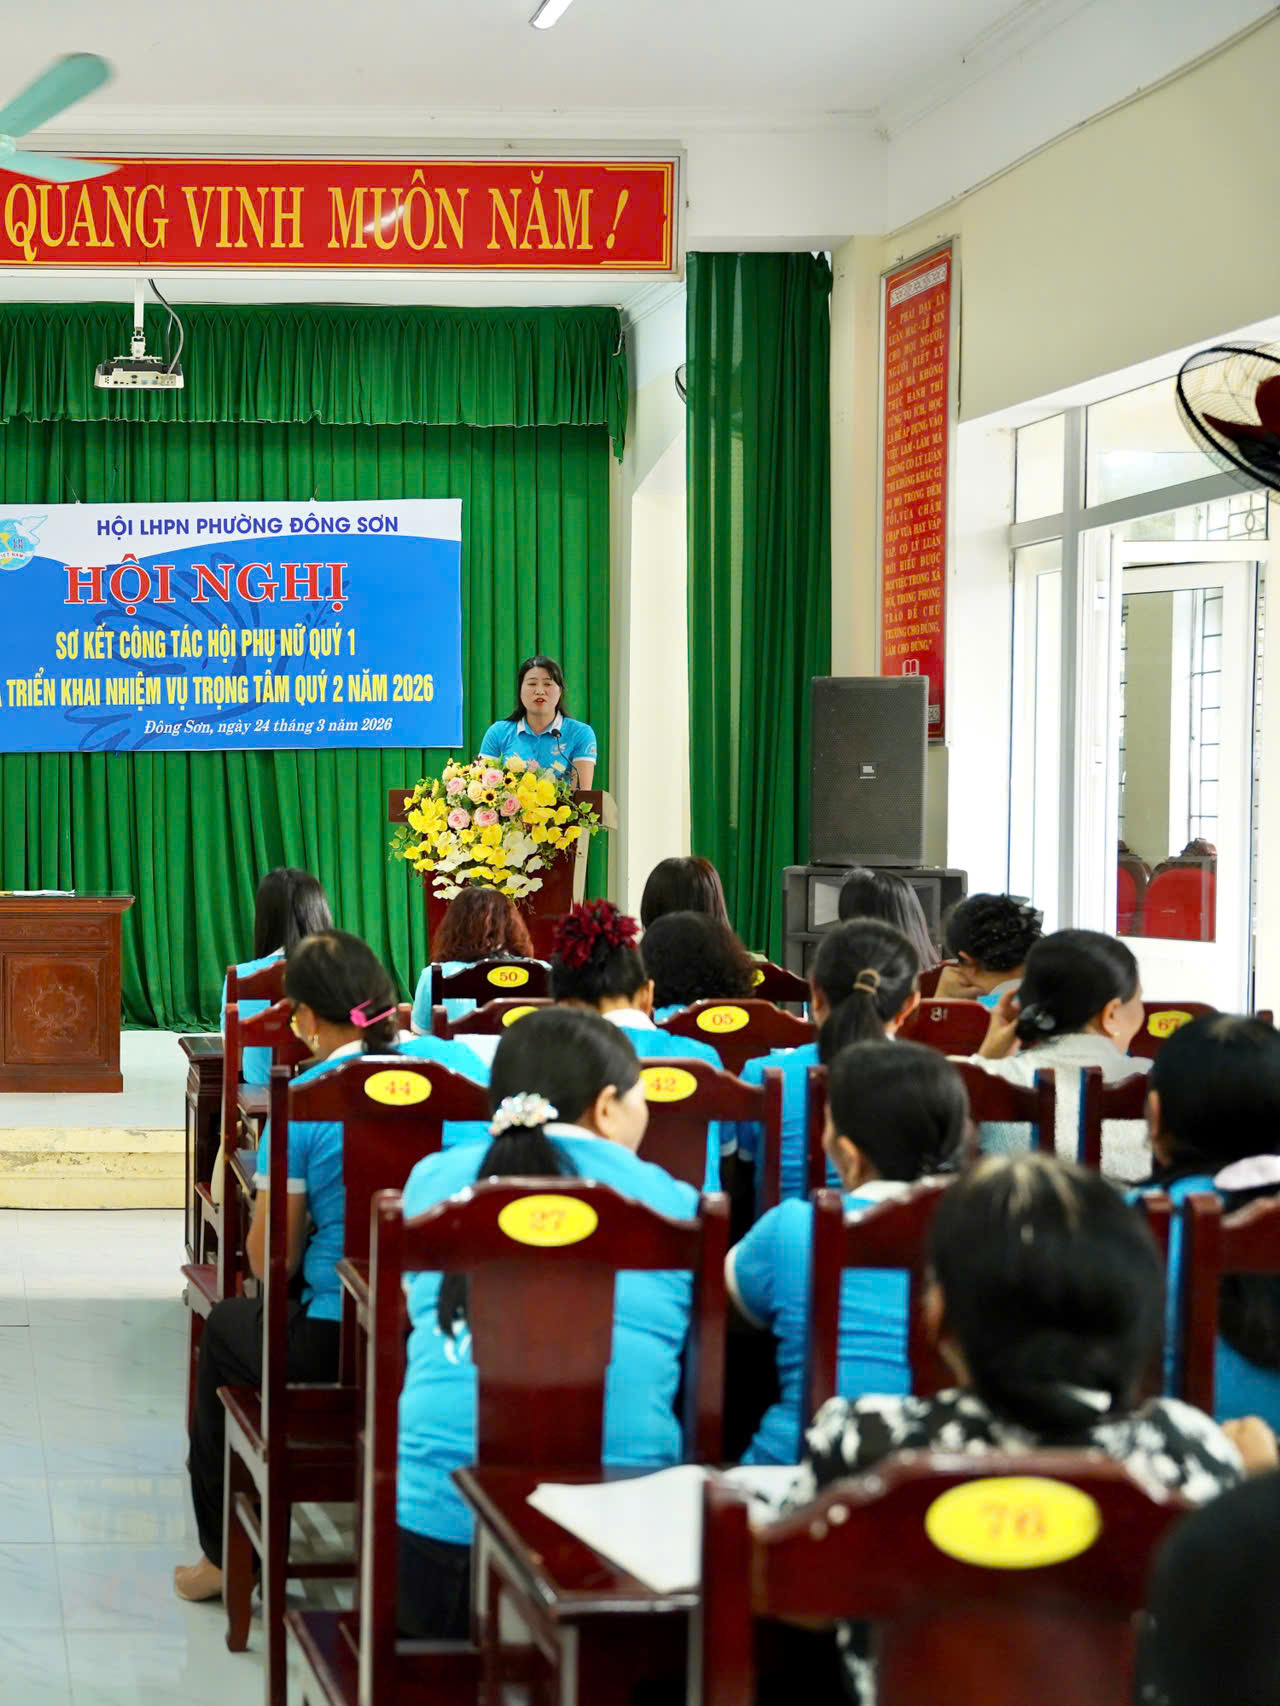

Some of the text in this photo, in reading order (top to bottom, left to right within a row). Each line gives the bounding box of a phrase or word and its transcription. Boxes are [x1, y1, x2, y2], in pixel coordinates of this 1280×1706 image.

[3, 184, 169, 262] QUANG
[182, 187, 304, 248] VINH
[329, 169, 468, 249] MUÔN
[487, 170, 593, 250] NĂM
[98, 513, 397, 540] HỘI LHPN PHƯỜNG ĐÔNG SƠN
[64, 553, 348, 615] HỘI NGHỊ
[56, 622, 355, 663] SƠ KẾT CÔNG TÁC HỘI PHỤ NỮ QUÝ 1
[7, 668, 55, 707] TRIỂN
[61, 679, 100, 705] KHAI
[106, 671, 161, 711] NHIỆM
[167, 677, 187, 710] VỤ
[193, 675, 248, 709] TRỌNG
[254, 670, 289, 703] TÂM
[296, 669, 327, 705] QUÝ
[333, 676, 343, 702] 2
[349, 669, 387, 702] NĂM
[393, 674, 433, 701] 2026
[144, 718, 392, 736] Đông Sơn, ngày 24 tháng 3 năm 2026
[499, 970, 518, 984] 50
